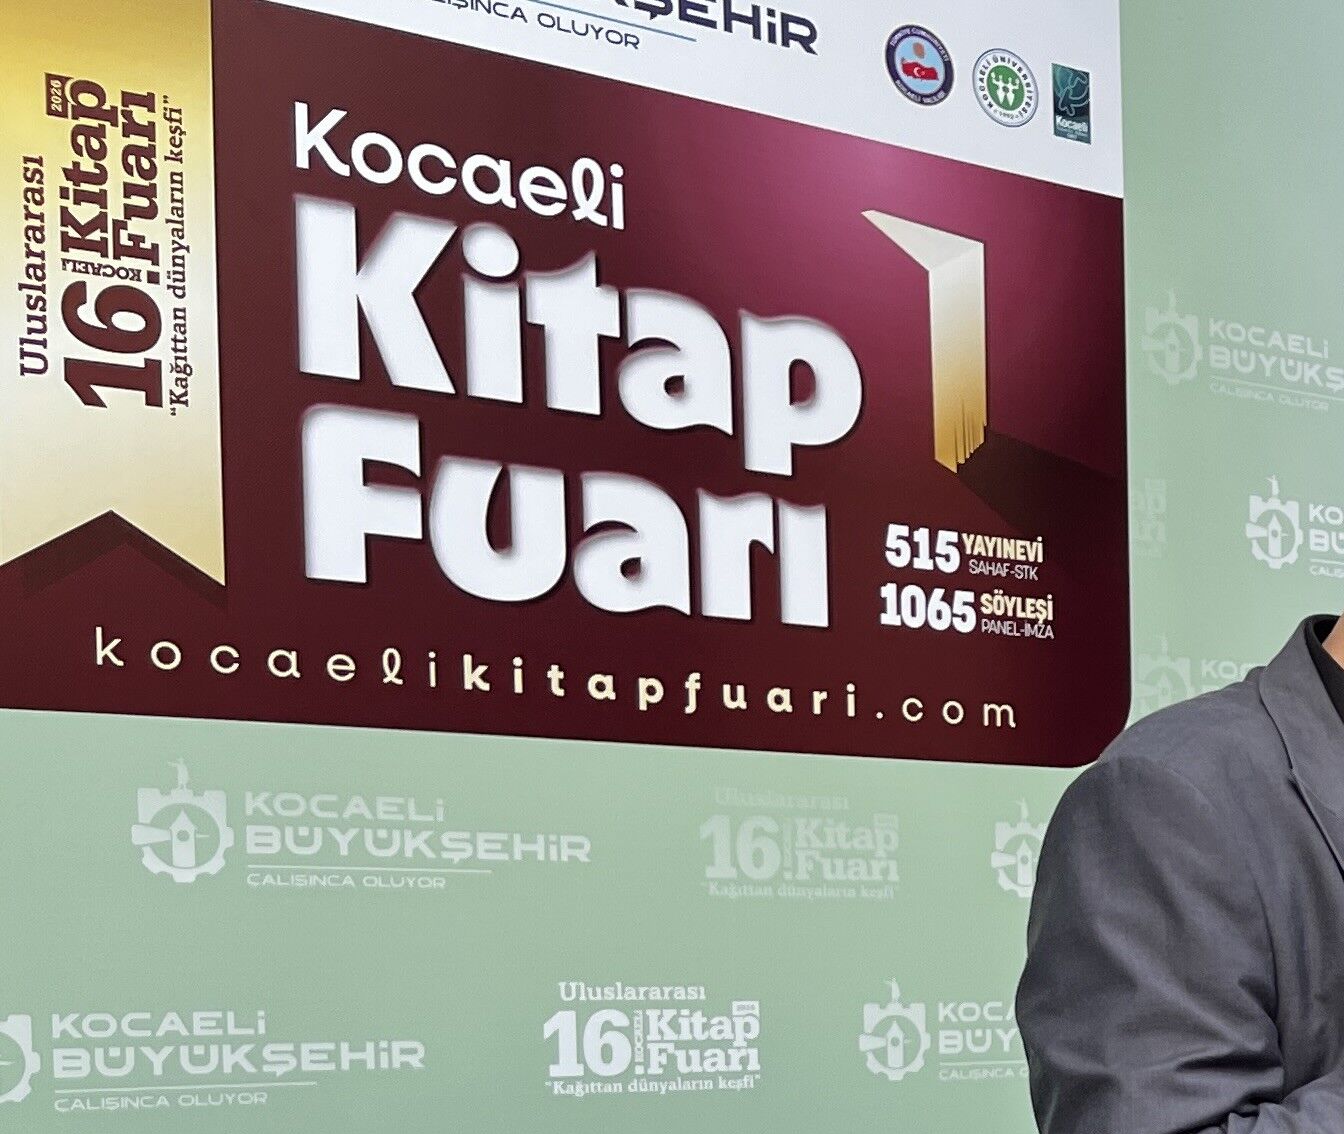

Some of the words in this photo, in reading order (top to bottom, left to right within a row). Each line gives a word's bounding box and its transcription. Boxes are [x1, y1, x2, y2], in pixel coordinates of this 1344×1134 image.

[537, 13, 640, 49] OLUYOR
[50, 79, 63, 113] 2026
[59, 79, 118, 260] Kitap
[112, 90, 160, 267] Fuarı
[294, 101, 625, 230] Kocaeli
[165, 172, 190, 300] dünyaların
[19, 155, 49, 377] Uluslararası
[293, 193, 862, 476] Kitap
[302, 403, 829, 627] Fuarı
[885, 523, 960, 573] 515
[962, 532, 1043, 563] YAYINEVİ
[969, 559, 1038, 581] SAHAF-STK
[880, 583, 977, 633] 1065
[980, 589, 1053, 624] SÖYLEŞİ
[981, 619, 1054, 639] PANEL-İMZA
[95, 627, 1016, 728] kocaelikitapfuari.com
[795, 817, 899, 858] Kitap
[558, 981, 706, 1001] Uluslararası
[646, 1009, 760, 1047] Kitap
[647, 1042, 760, 1075] Fuarı
